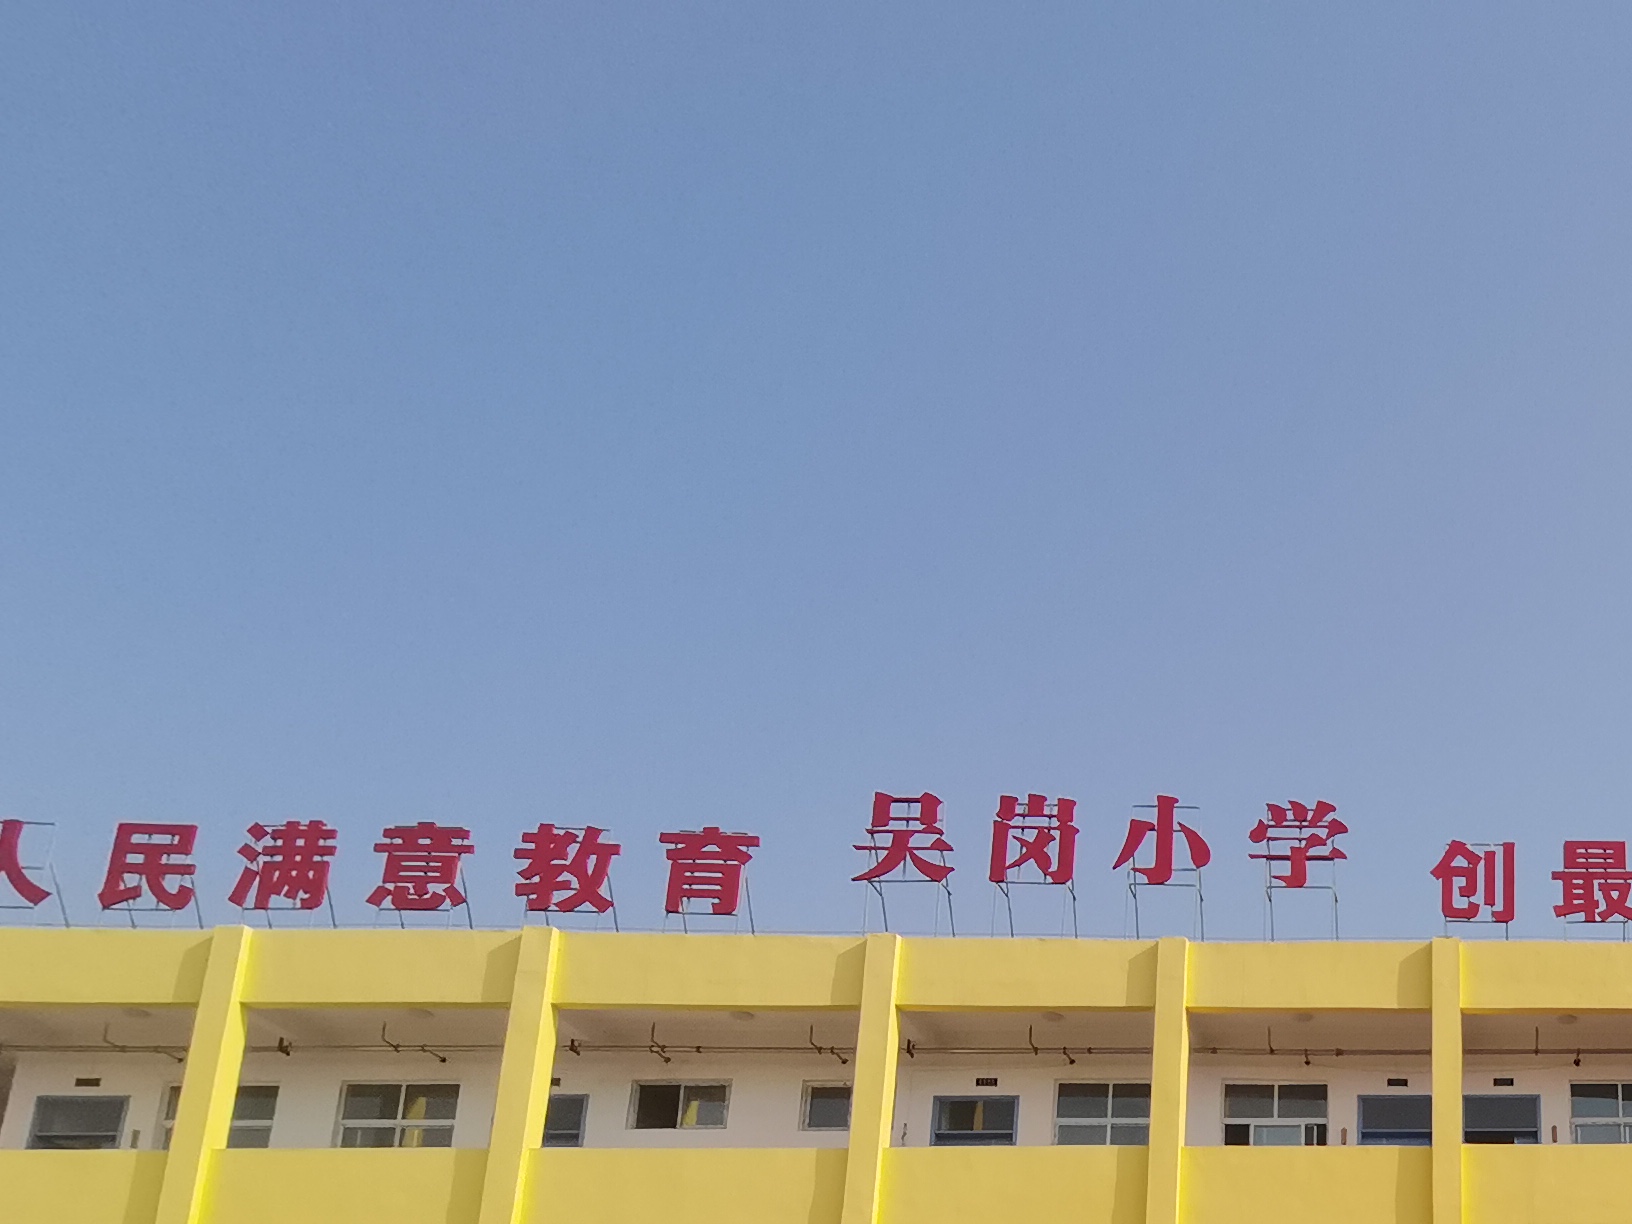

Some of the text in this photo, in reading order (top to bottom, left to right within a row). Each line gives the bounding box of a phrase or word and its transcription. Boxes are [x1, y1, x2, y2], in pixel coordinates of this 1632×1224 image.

[0, 819, 760, 914] 人民满意教育
[851, 791, 1349, 888] 吴岗小学
